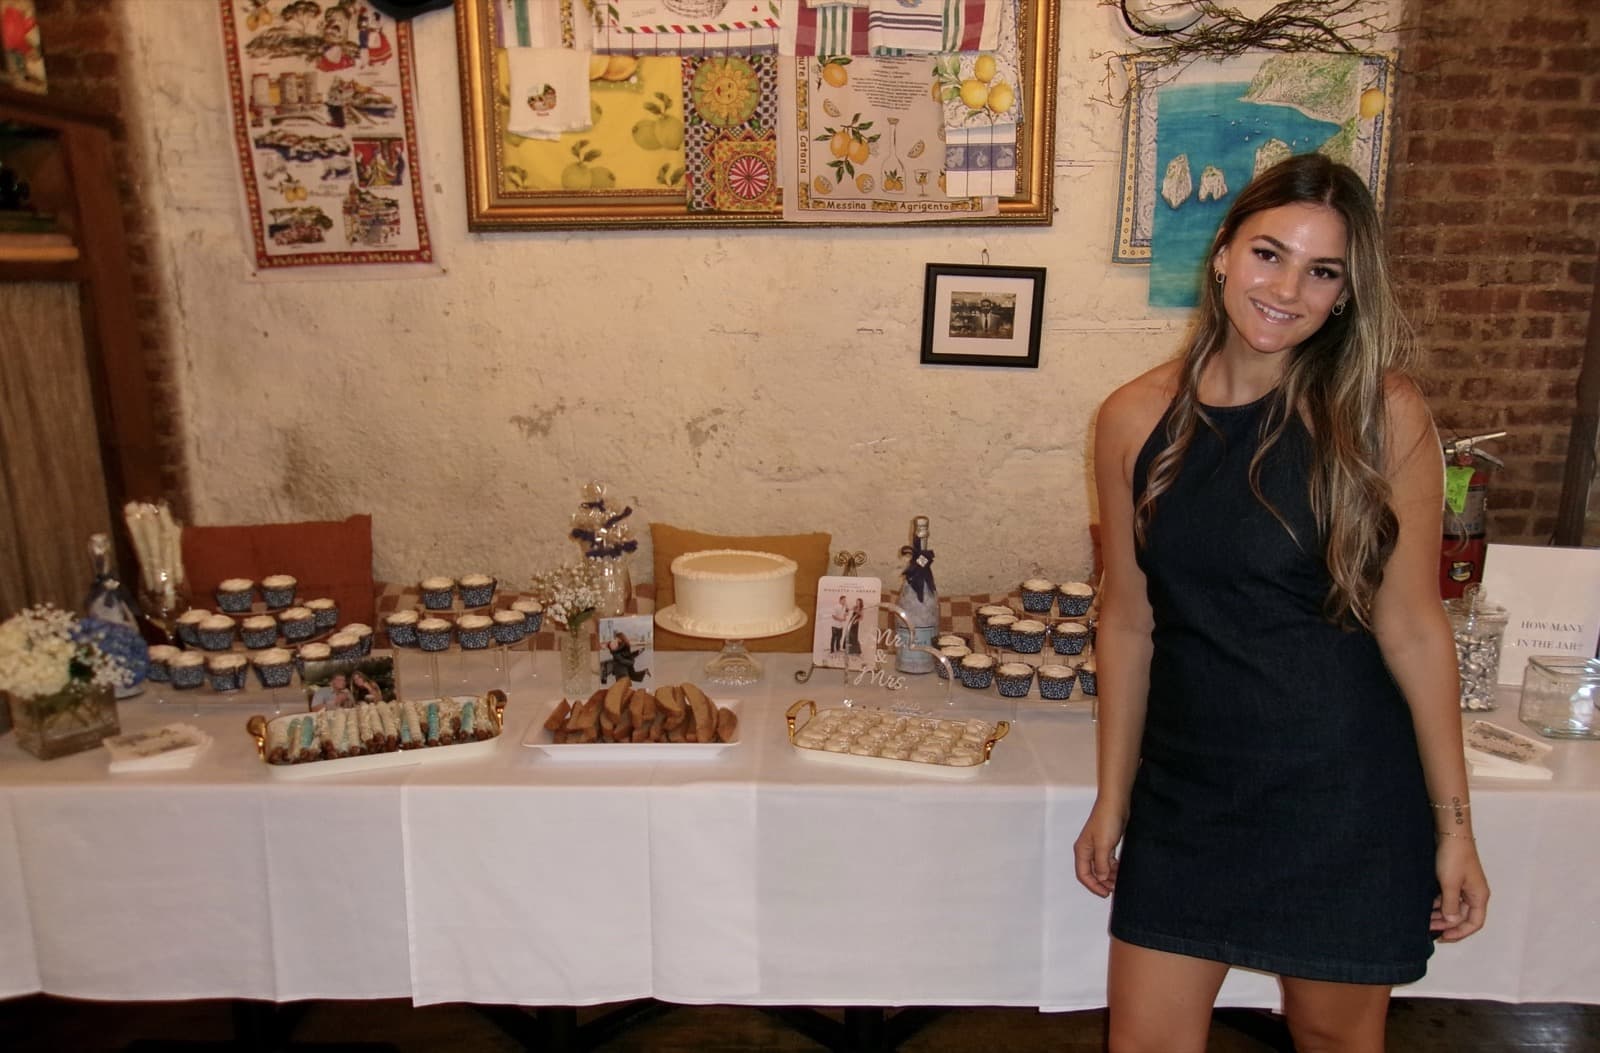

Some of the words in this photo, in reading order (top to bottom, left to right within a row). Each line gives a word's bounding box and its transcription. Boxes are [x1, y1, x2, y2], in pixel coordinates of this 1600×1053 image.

[799, 135, 809, 174] Catania
[826, 200, 867, 210] Messina
[899, 201, 950, 212] Agrigento
[1521, 620, 1548, 630] HOW
[1550, 623, 1584, 633] MANY
[1517, 639, 1529, 648] IN
[1530, 639, 1552, 649] THE
[874, 648, 888, 664] &
[854, 667, 908, 690] Mrs.
